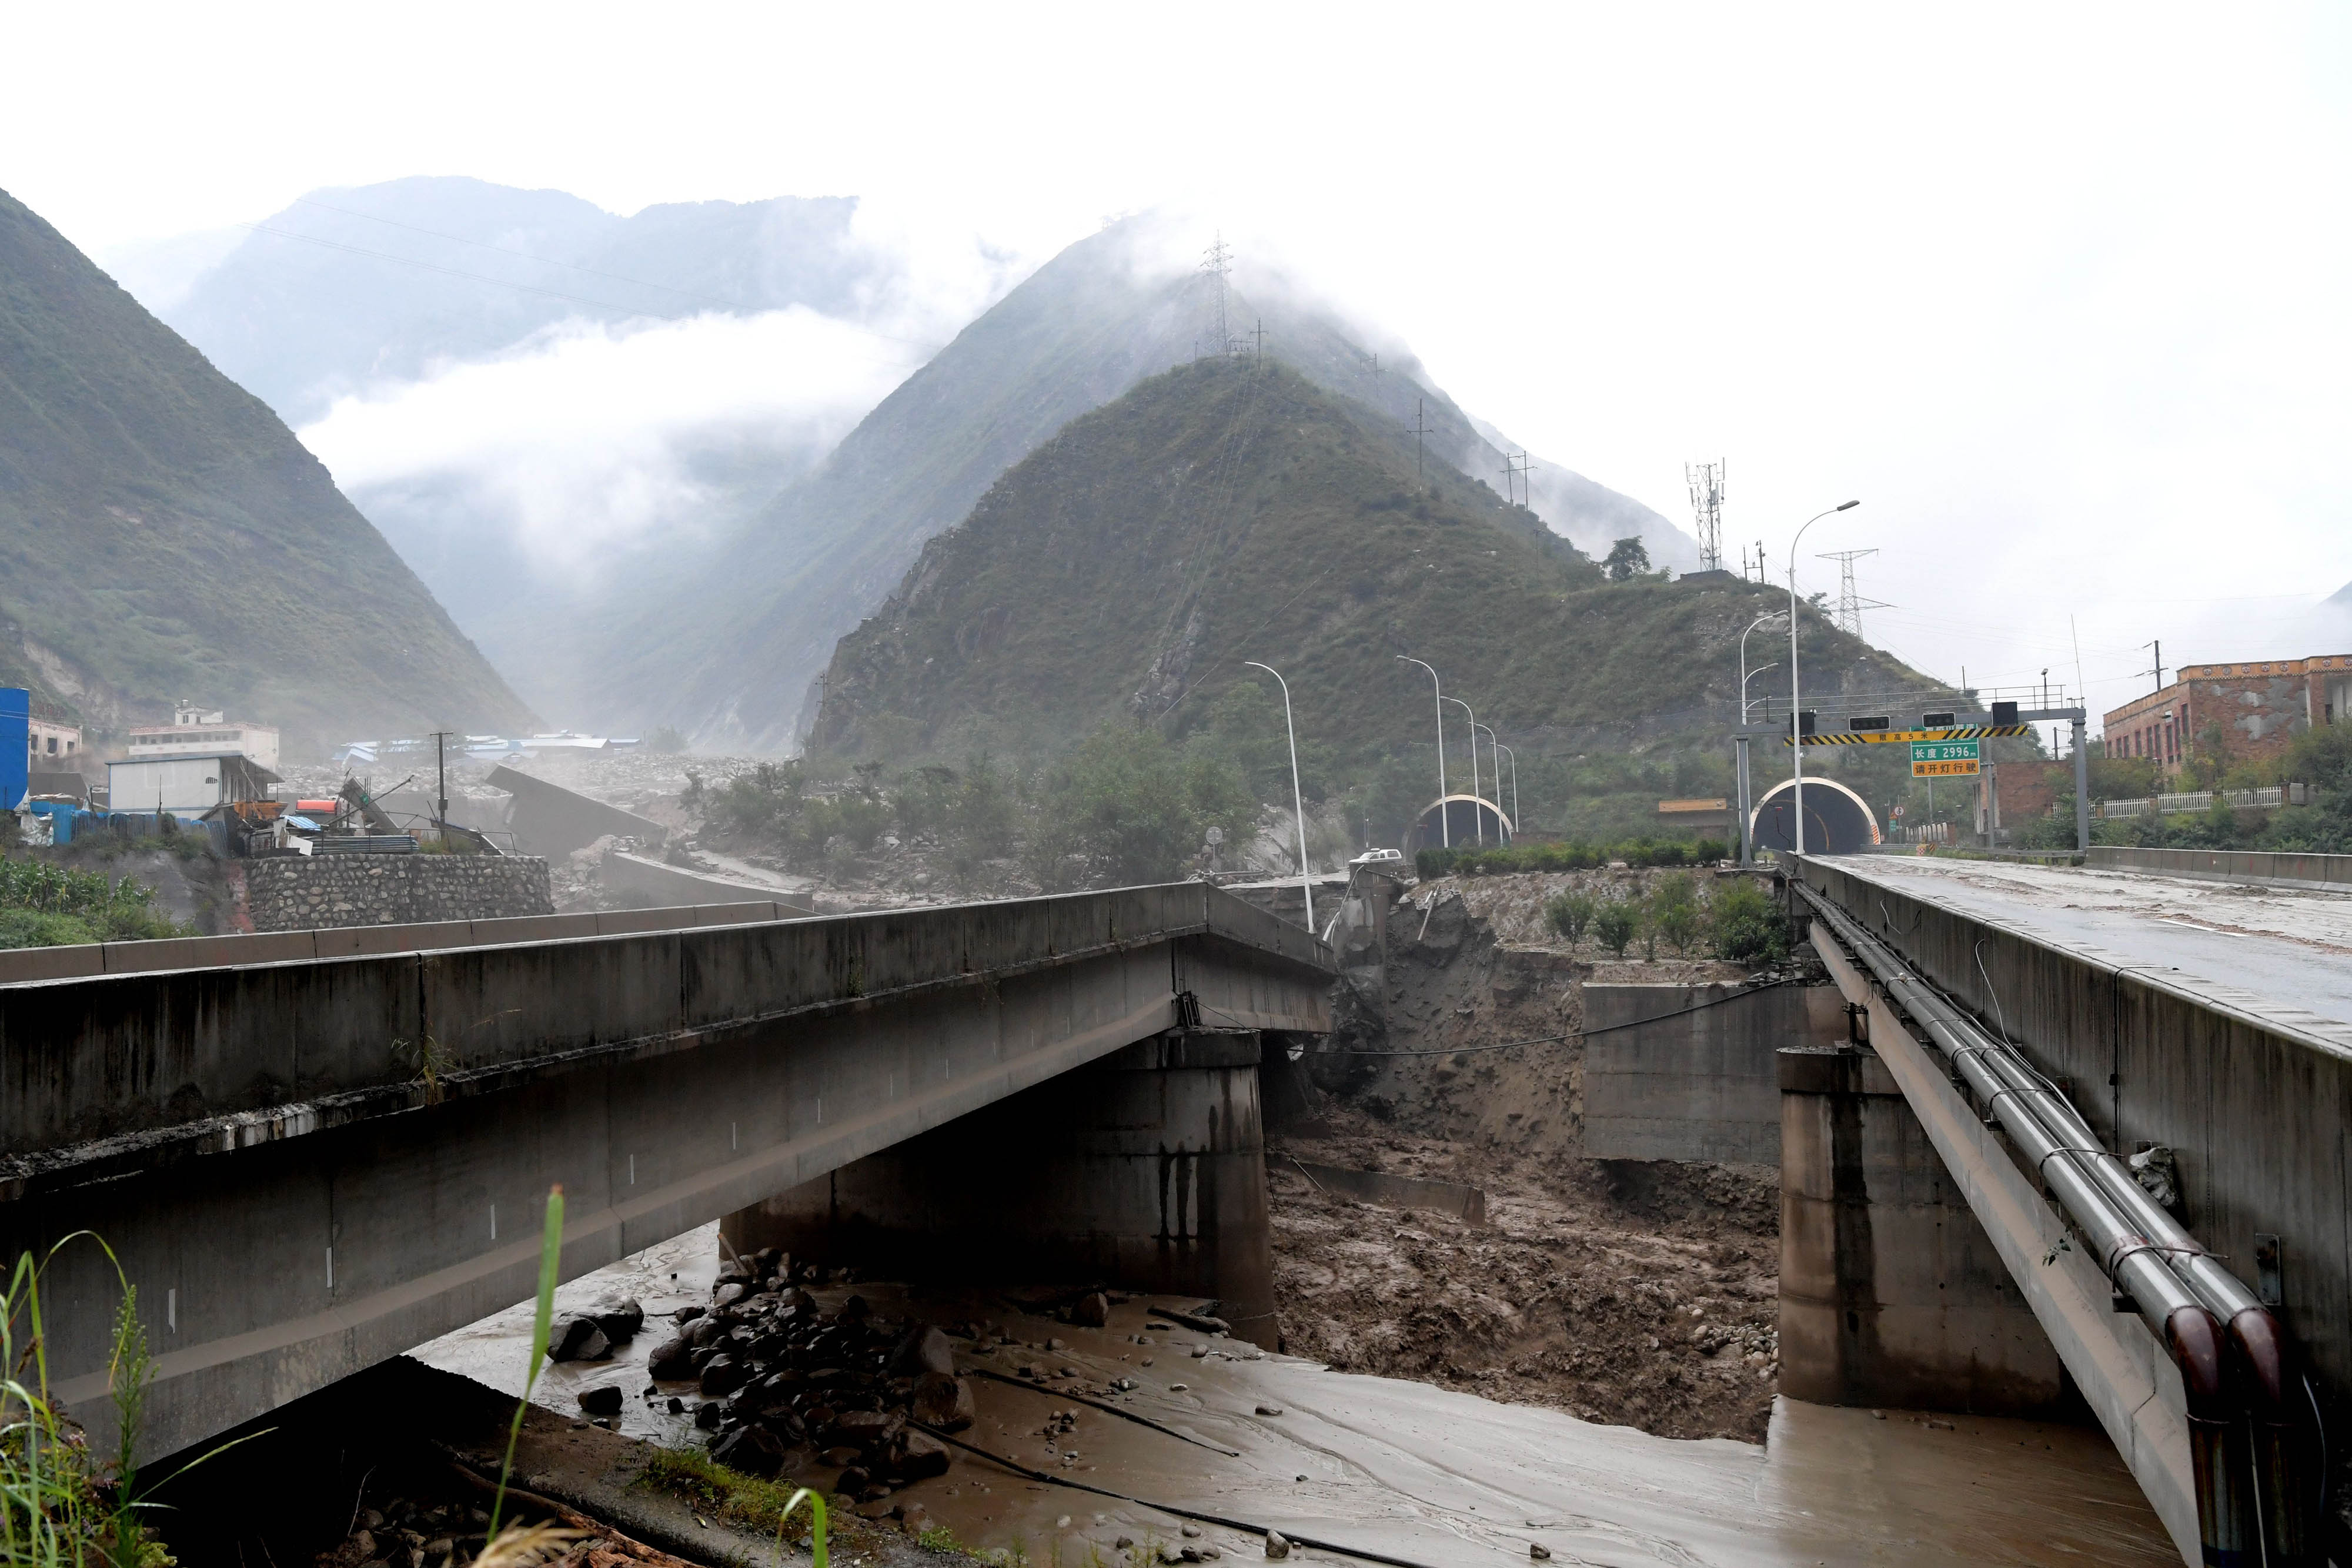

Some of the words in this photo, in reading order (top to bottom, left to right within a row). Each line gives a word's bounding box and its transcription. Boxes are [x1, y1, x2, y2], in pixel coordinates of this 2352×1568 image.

[1879, 732, 1928, 741] 限高5米
[1915, 763, 1976, 774] 请开灯行驶
